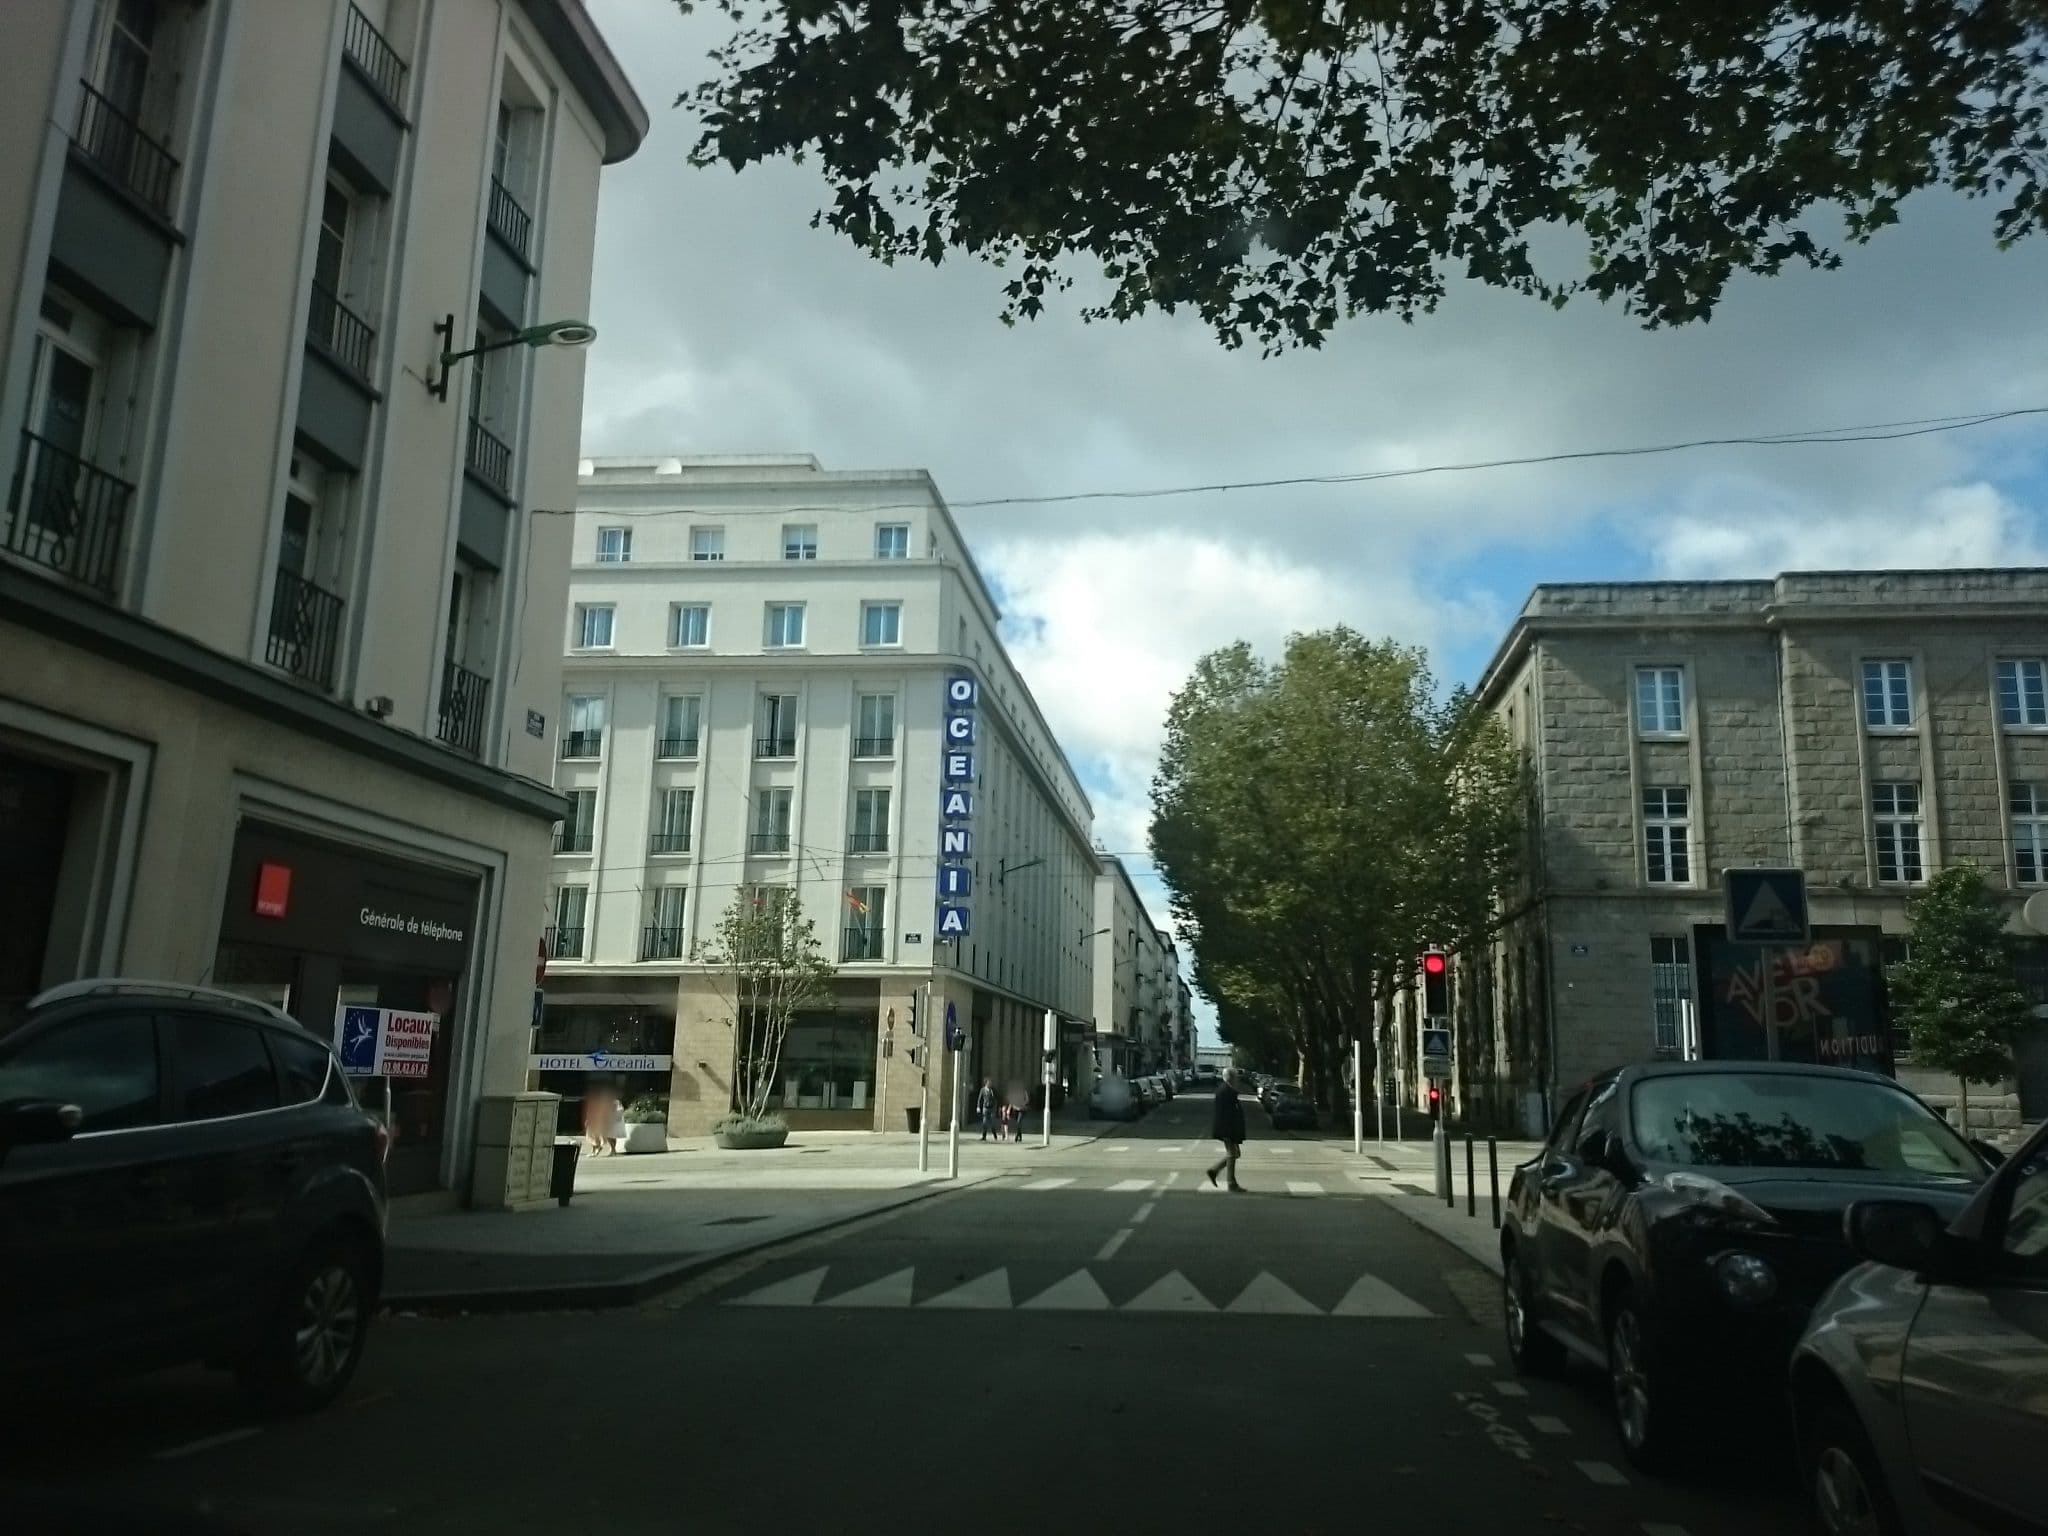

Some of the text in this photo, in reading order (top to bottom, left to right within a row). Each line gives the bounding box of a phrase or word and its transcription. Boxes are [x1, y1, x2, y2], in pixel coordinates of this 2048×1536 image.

[941, 681, 970, 931] OCEANIA
[360, 907, 463, 942] Générale de téléphone
[387, 1012, 432, 1035] Locaux
[385, 1034, 430, 1050] Disponibles
[540, 1053, 655, 1069] HOTEL Oceania
